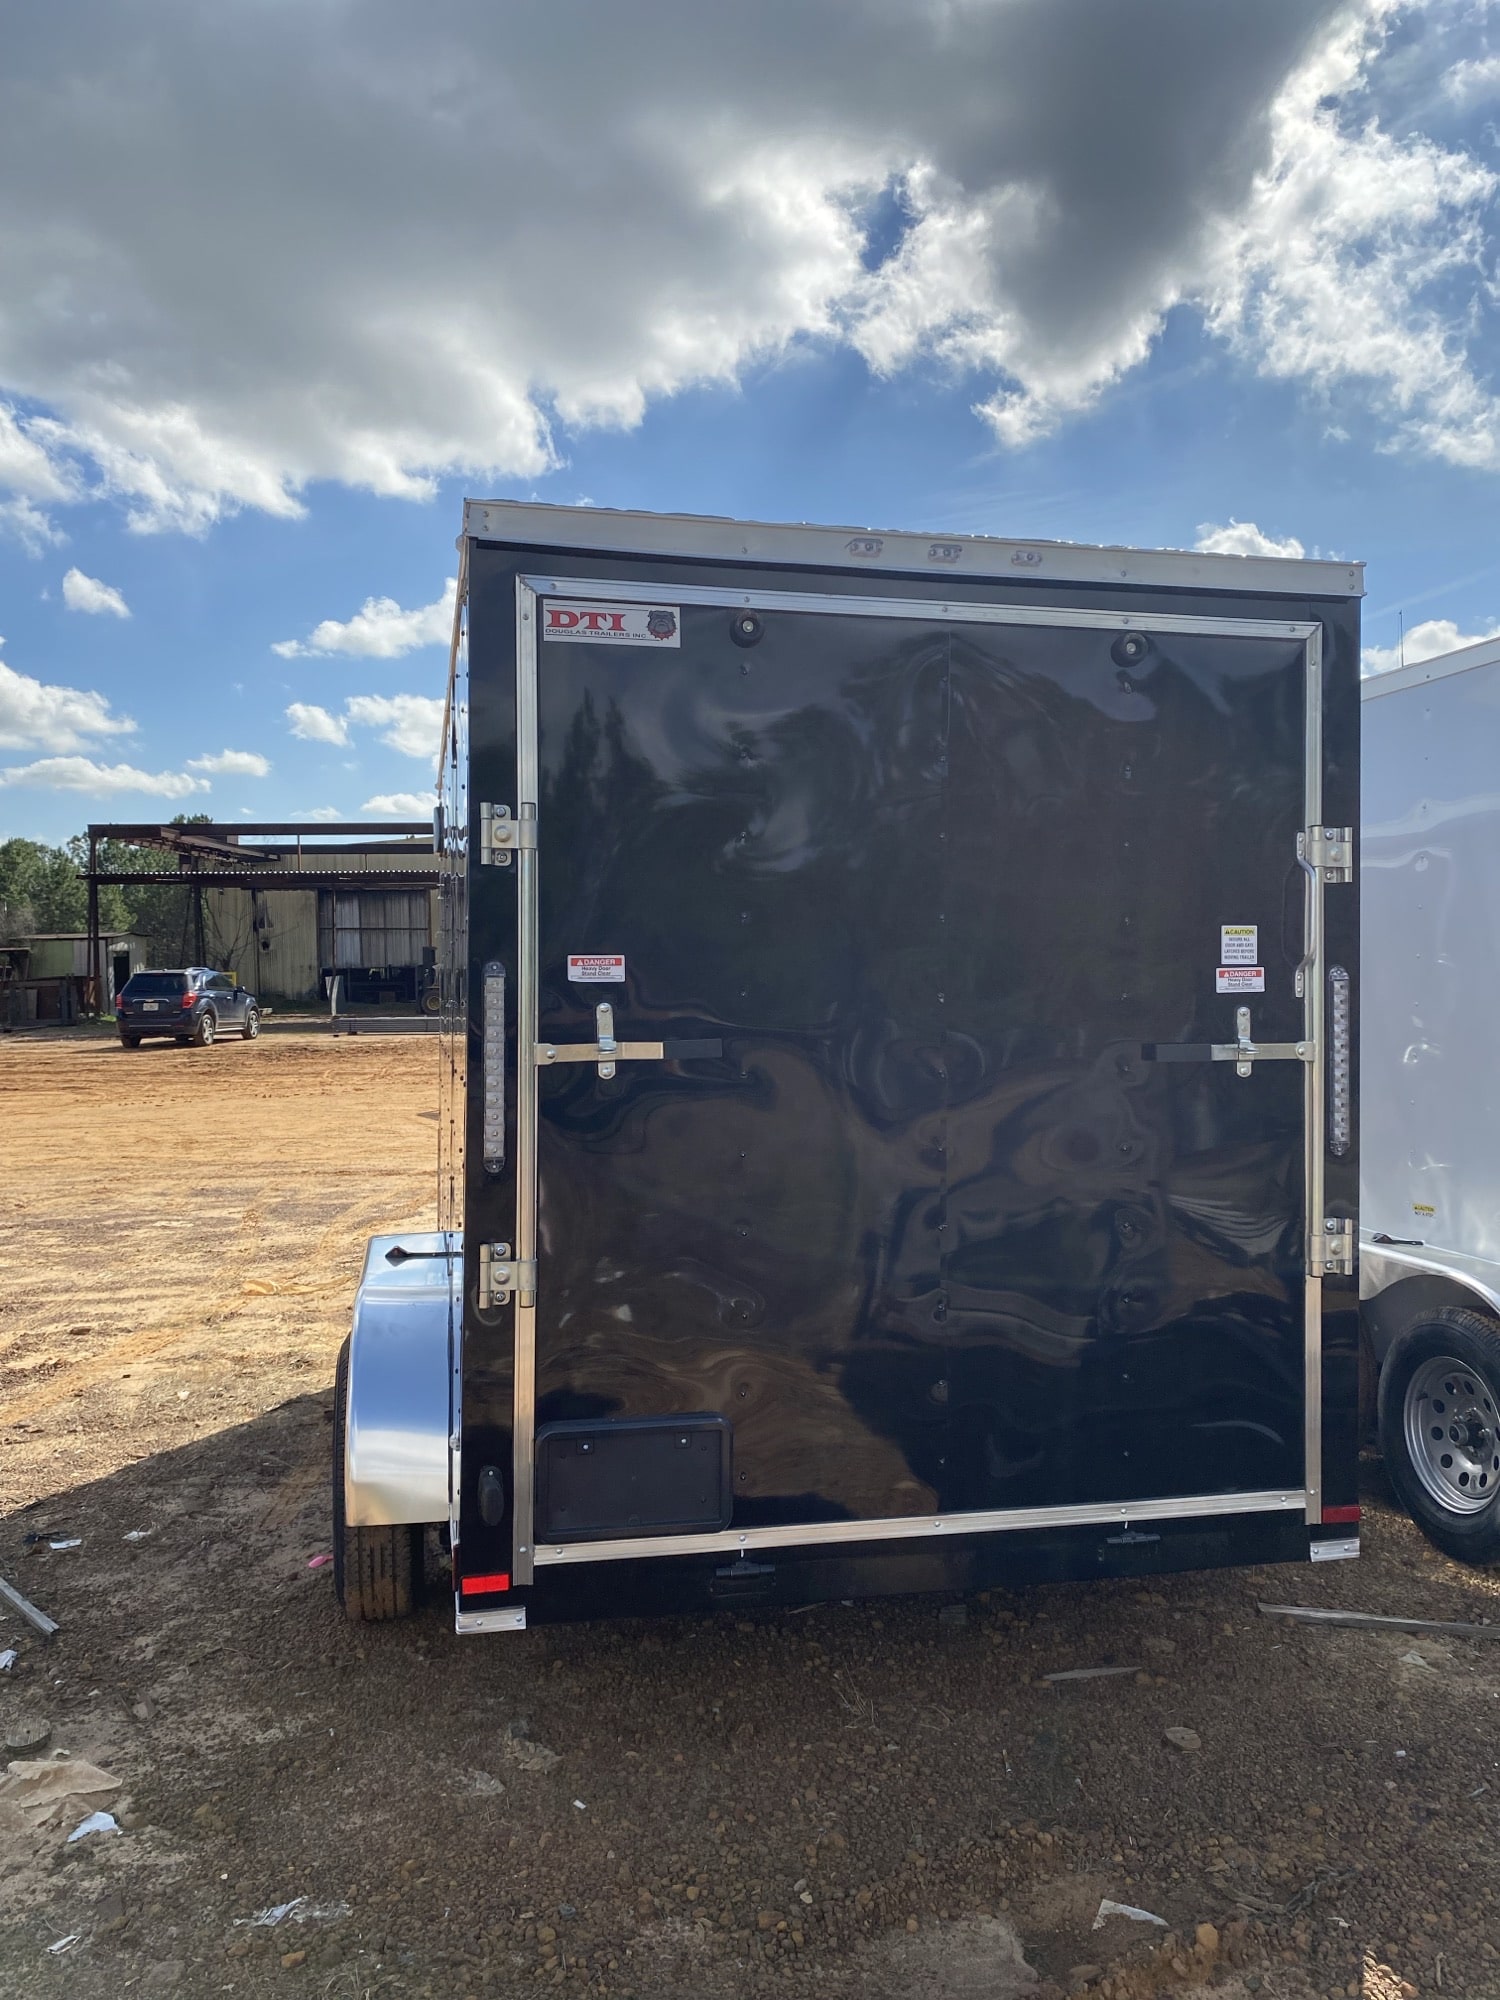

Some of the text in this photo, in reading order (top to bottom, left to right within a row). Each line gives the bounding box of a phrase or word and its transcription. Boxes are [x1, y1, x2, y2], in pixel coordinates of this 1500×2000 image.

[546, 609, 626, 631] DTI
[589, 630, 631, 638] TRAILERS
[583, 958, 616, 966] DANGER
